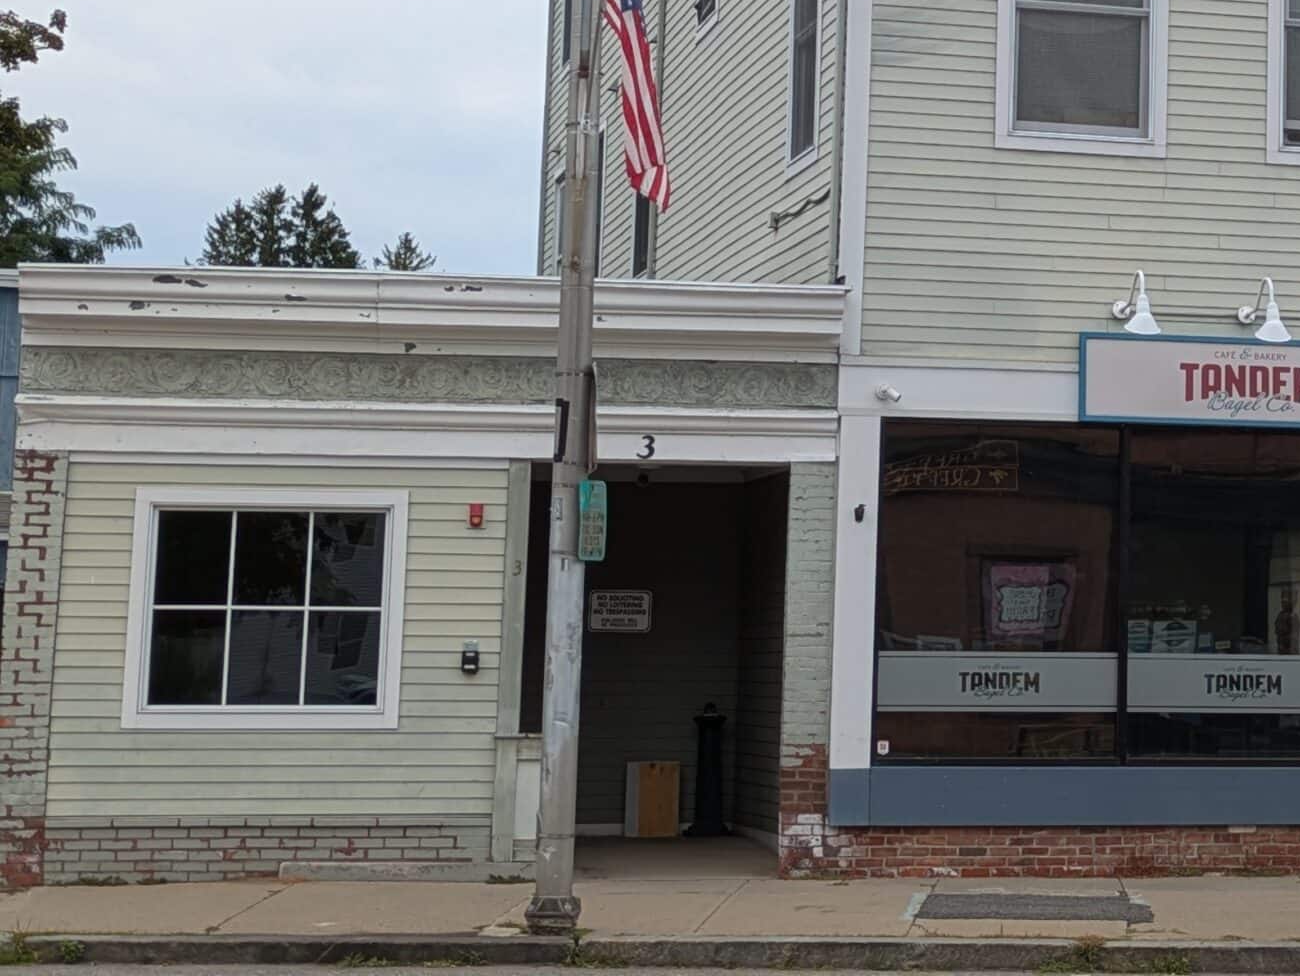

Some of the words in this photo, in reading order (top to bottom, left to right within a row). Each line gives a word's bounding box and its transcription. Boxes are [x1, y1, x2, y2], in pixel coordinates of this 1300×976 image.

[1239, 348, 1252, 361] &
[1254, 352, 1287, 362] BAKERY
[1207, 391, 1261, 418] Bagel
[636, 435, 656, 459] 3
[511, 559, 522, 576] 3
[958, 672, 1040, 693] TANDEM
[1204, 674, 1282, 695] TANDEM
